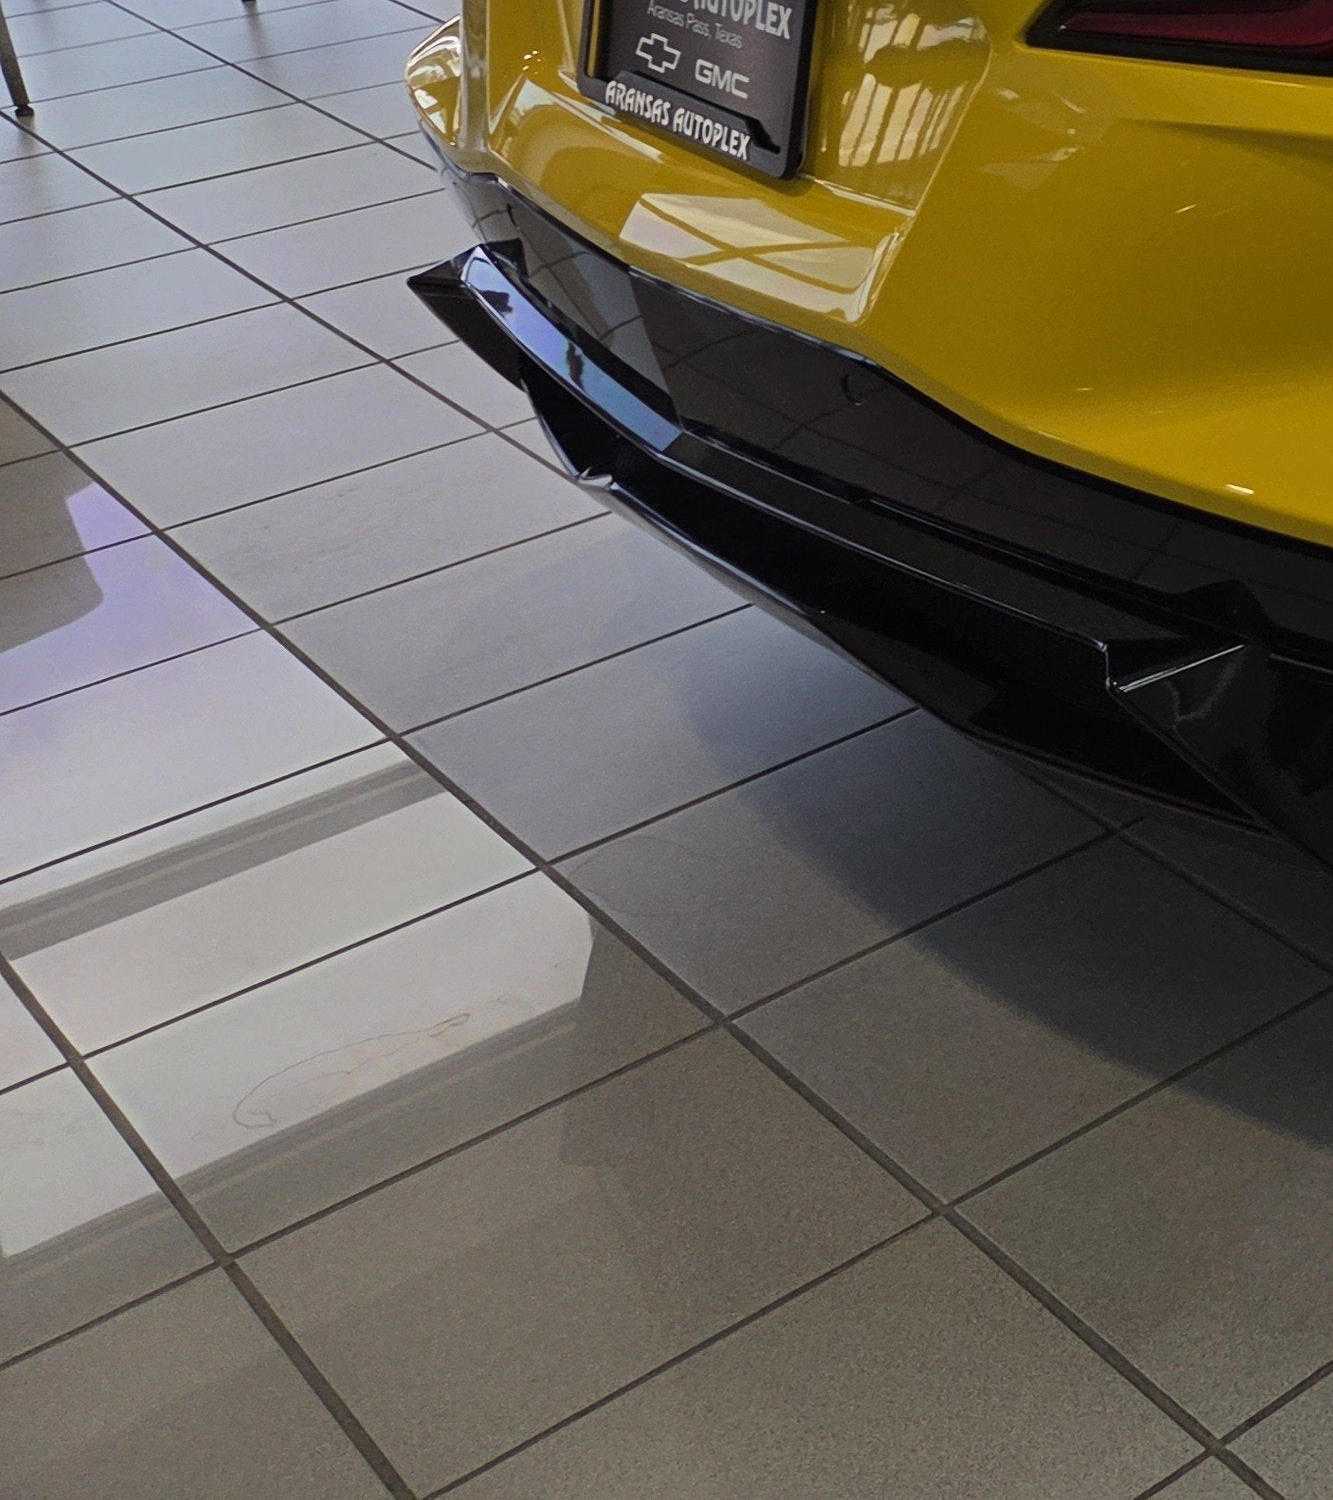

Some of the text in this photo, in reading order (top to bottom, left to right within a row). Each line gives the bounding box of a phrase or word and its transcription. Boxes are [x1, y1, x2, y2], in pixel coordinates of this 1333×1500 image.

[646, 0, 685, 28] Aransas
[714, 22, 743, 49] Texas
[694, 58, 750, 99] GMC
[605, 80, 751, 161] ARANSAS AUTOPLEX
